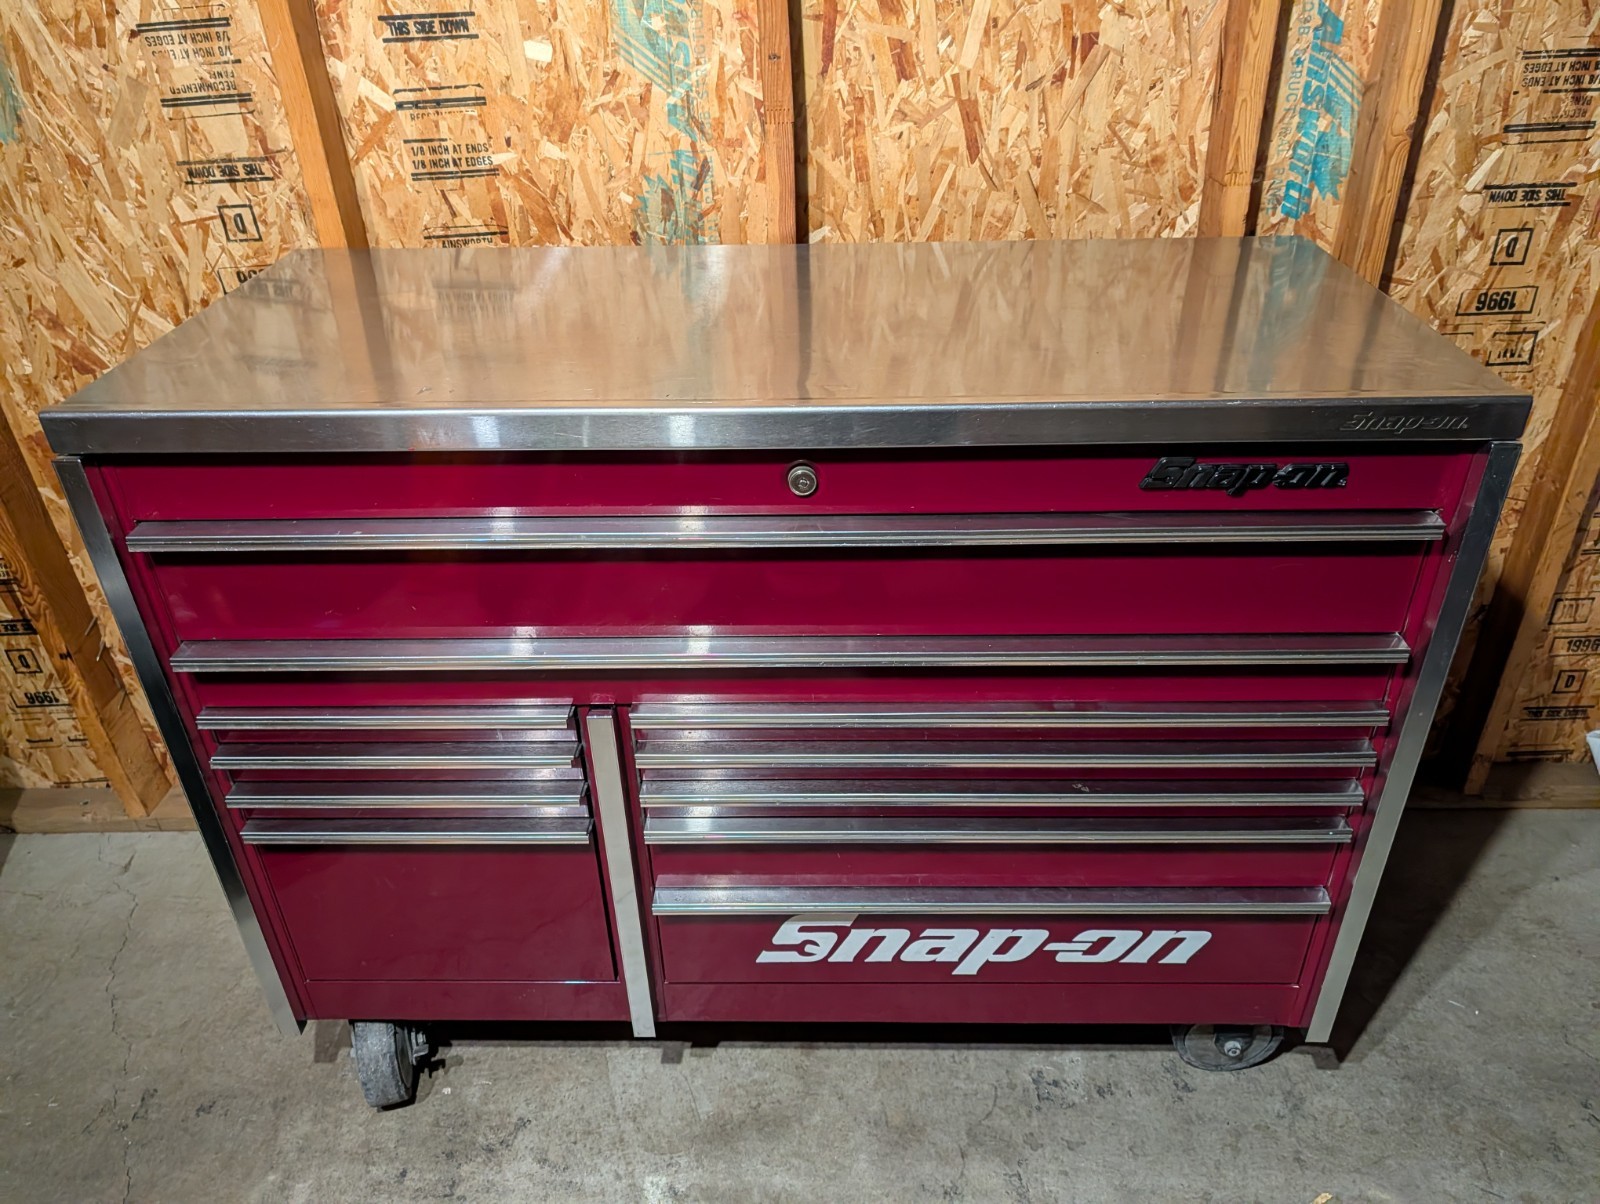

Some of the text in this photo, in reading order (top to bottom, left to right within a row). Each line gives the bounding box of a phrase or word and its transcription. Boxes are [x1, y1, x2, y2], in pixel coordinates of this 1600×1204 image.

[389, 18, 469, 36] THIS SIDE DOWN
[145, 31, 231, 47] 1/8 INCH AT EDGES
[181, 49, 190, 60] AT
[193, 47, 215, 59] INCH
[1523, 62, 1553, 74] EDGES
[1555, 61, 1568, 71] AT
[1568, 60, 1592, 72] INCH
[1548, 75, 1561, 86] AT
[1563, 74, 1585, 86] INCH
[1276, 48, 1308, 157] STRUCTRAL
[410, 142, 489, 157] 1/8 INCH AT ENDS
[412, 155, 494, 170] 1/8 INCH AT EDGES
[187, 163, 265, 178] THIS SIDE DOWN
[1488, 188, 1566, 203] THIS SIDE DOWN
[233, 212, 248, 234] D
[1505, 236, 1519, 258] D
[1475, 291, 1517, 312] 1996
[1339, 412, 1467, 434] Snap-on
[1139, 457, 1349, 496] Snap-on
[1567, 639, 1600, 653] 1996
[1564, 674, 1576, 688] D
[755, 914, 1212, 975] Snap-on
